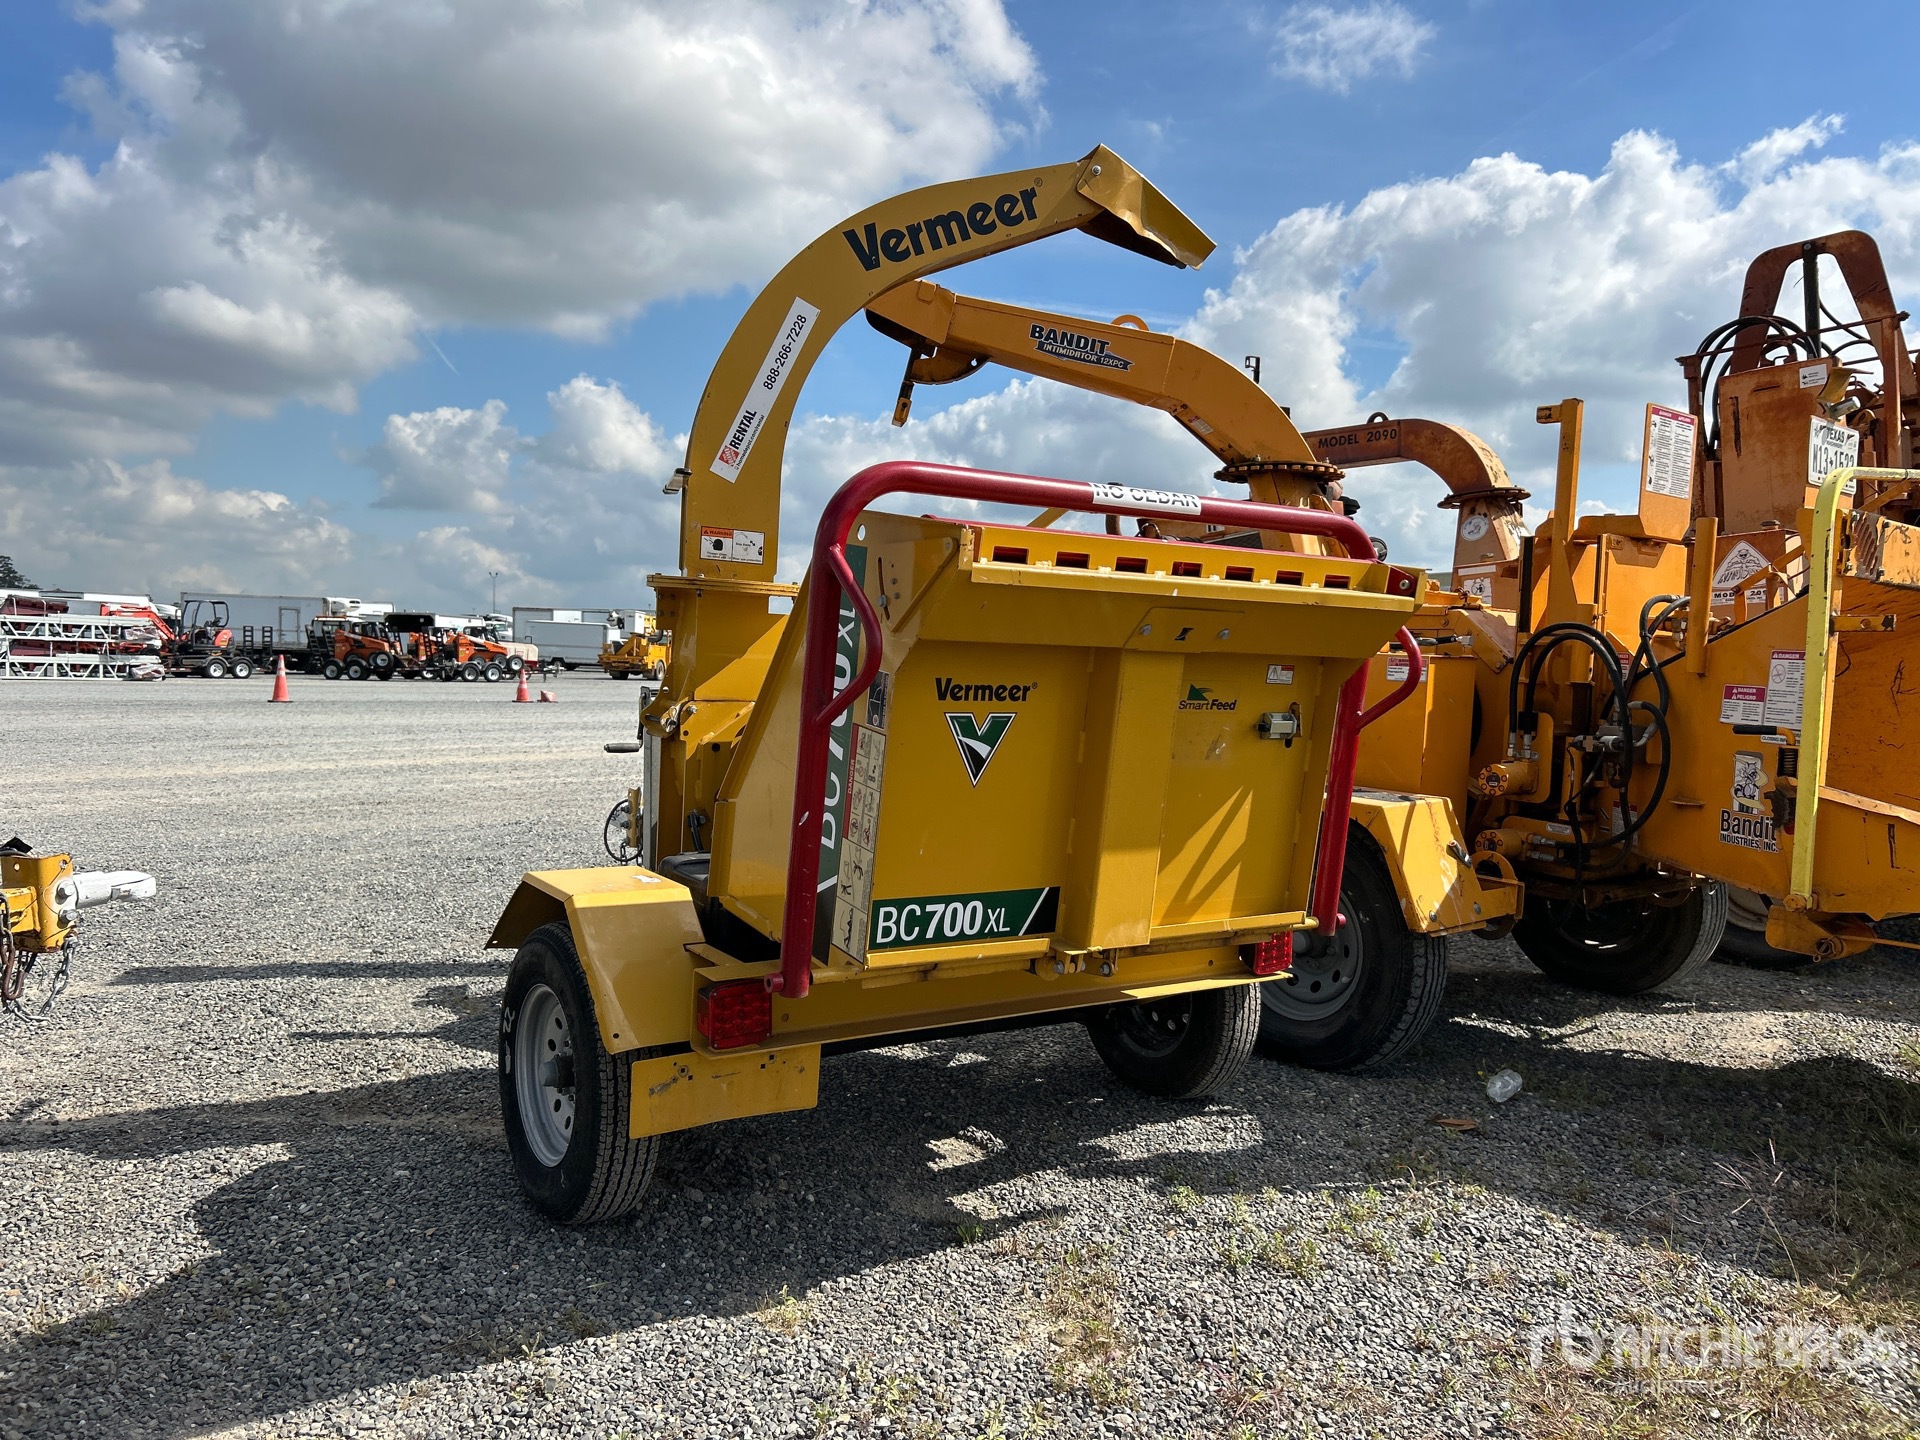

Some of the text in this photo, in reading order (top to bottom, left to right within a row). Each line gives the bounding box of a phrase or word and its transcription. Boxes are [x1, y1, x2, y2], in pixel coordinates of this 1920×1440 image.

[1030, 324, 1109, 355] BANDIT
[1043, 344, 1125, 368] INTIMIDATOR 12XPC
[729, 409, 757, 450] RENTAL
[763, 314, 807, 390] 888-266-7228
[1318, 429, 1397, 448] MODEL 2090
[1826, 427, 1845, 443] TEXAS
[1093, 483, 1124, 499] NO
[1714, 591, 1735, 599] MOD
[1178, 699, 1237, 710] SmartFeed
[847, 758, 856, 796] DANGER
[1720, 809, 1777, 841] Bandit
[1719, 833, 1778, 852] INDUSTRIES, INC.
